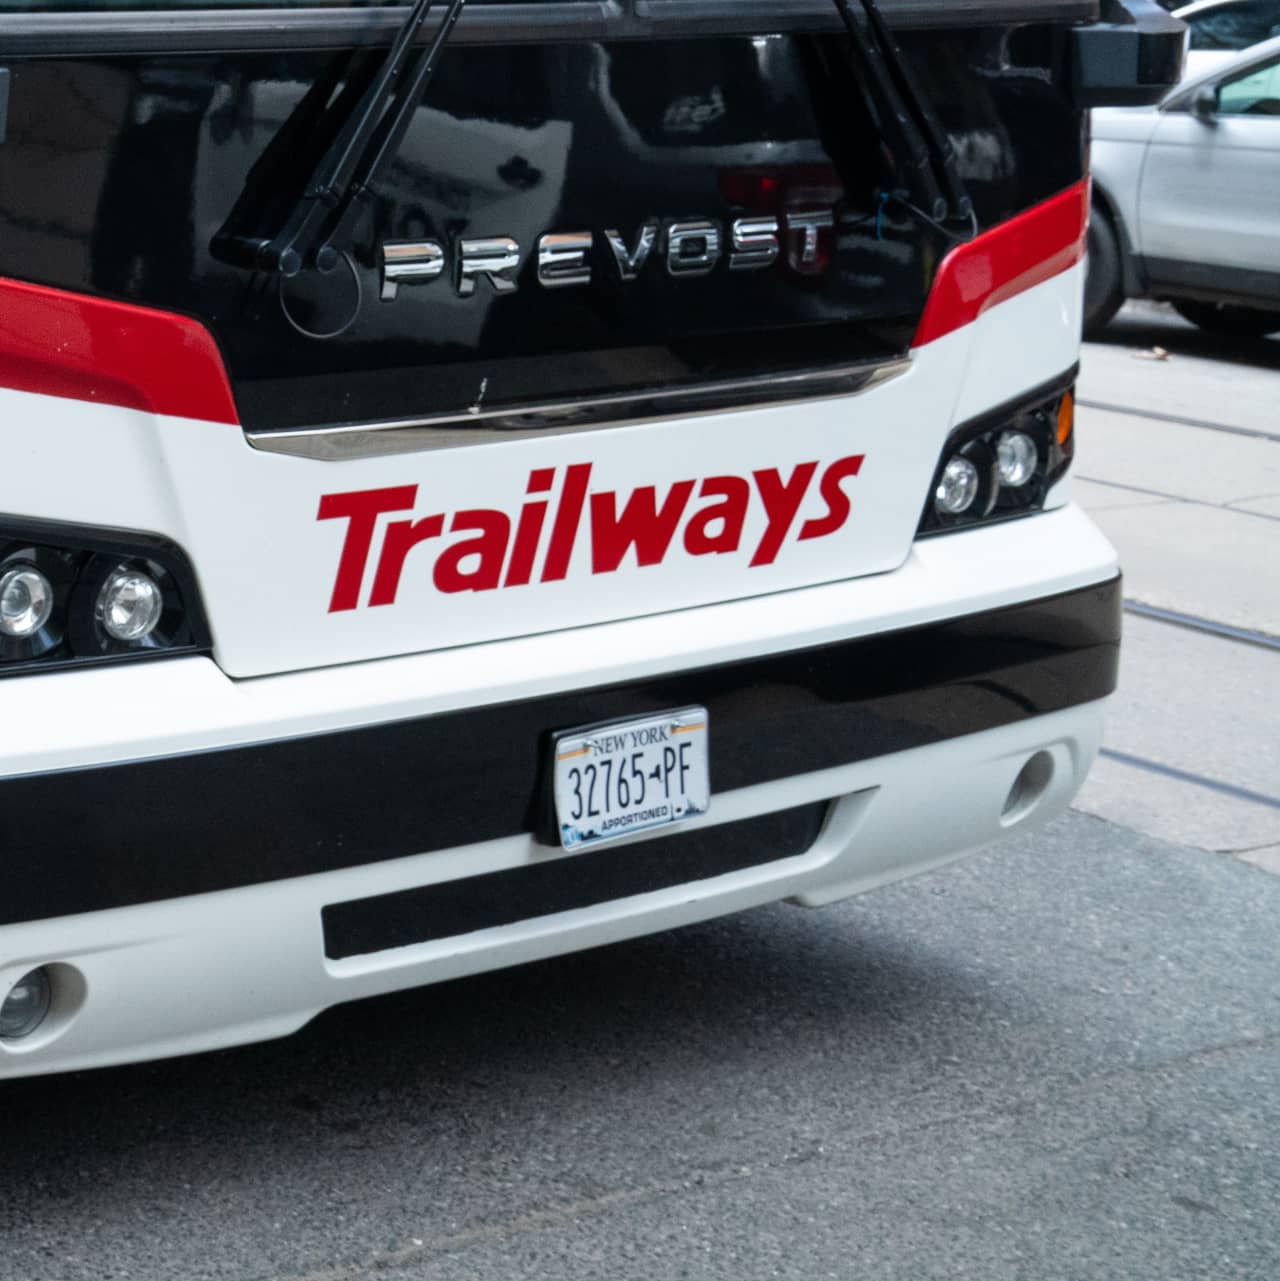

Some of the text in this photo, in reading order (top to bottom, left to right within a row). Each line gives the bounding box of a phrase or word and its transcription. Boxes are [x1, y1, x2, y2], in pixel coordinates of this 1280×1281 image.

[379, 210, 834, 303] PREVOST
[316, 453, 865, 613] Trailways
[594, 724, 669, 756] NEW YORK
[601, 805, 669, 831] APPORTIONED
